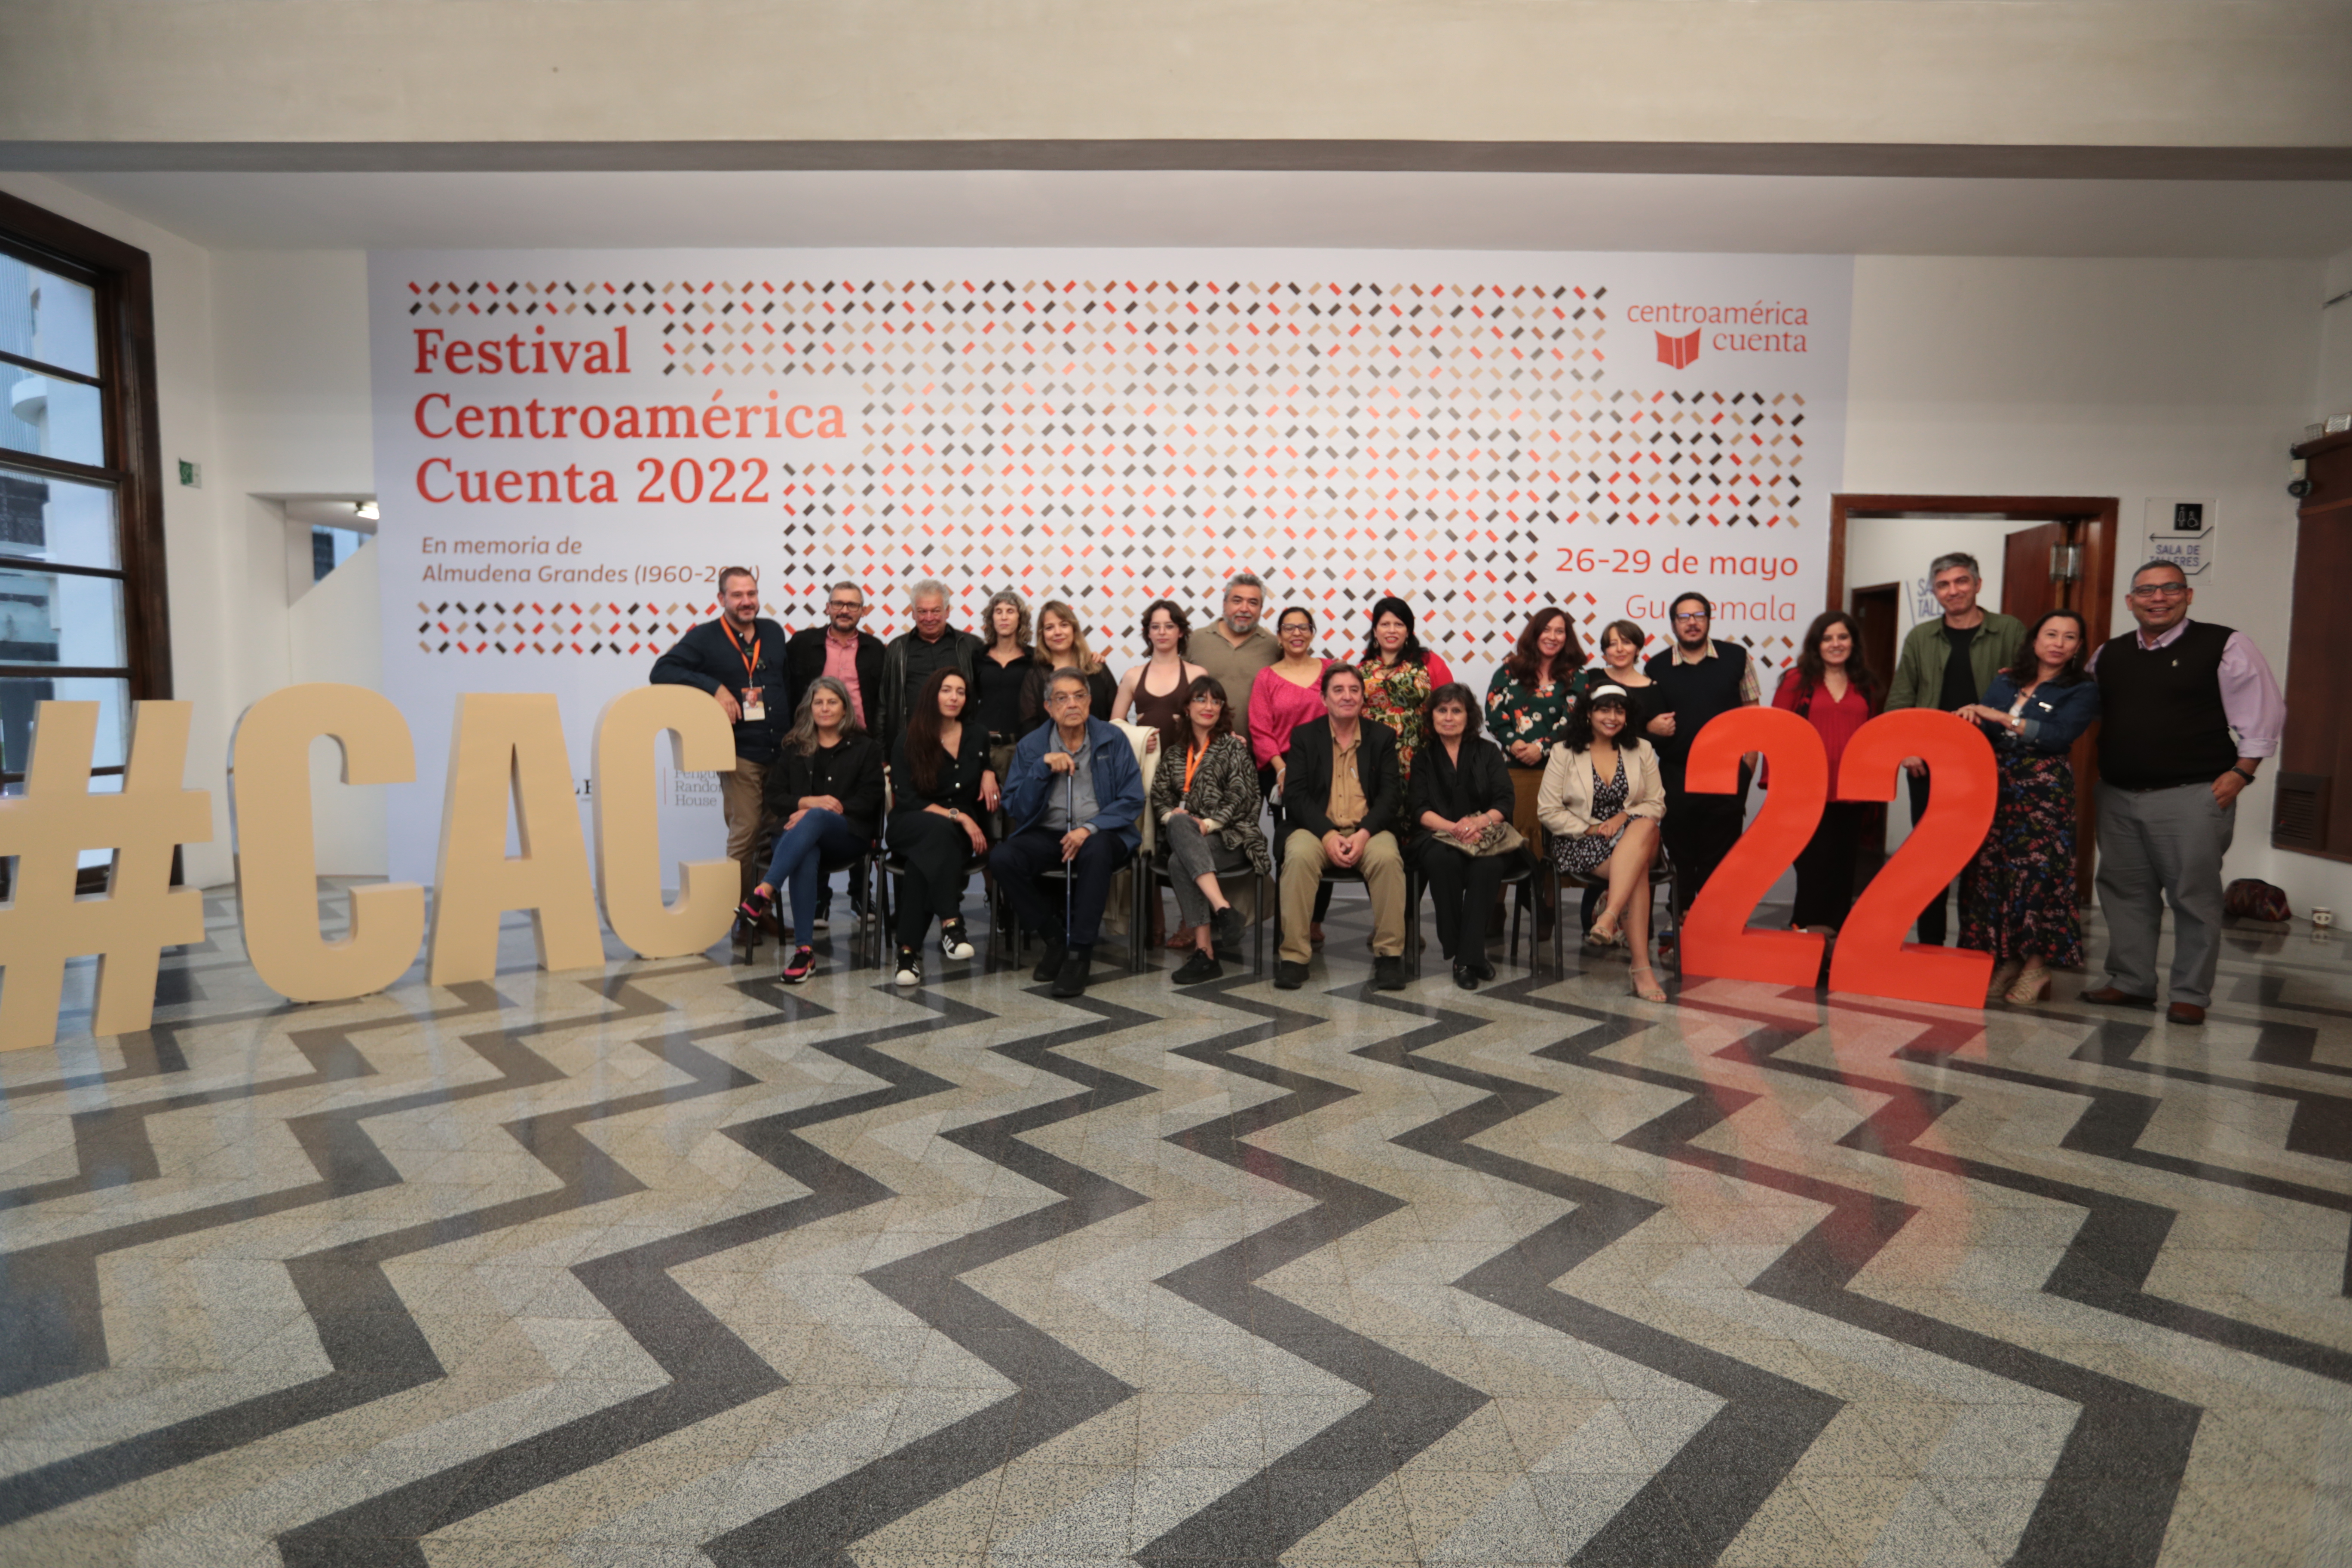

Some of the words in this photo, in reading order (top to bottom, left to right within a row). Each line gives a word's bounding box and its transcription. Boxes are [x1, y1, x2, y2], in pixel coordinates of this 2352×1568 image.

[1627, 300, 1809, 325] centroamérica
[412, 324, 632, 375] Festival
[1712, 332, 1808, 352] cuenta
[413, 388, 848, 439] Centroamérica
[415, 456, 619, 504] Cuenta
[636, 456, 770, 504] 2022
[422, 537, 447, 554] En
[453, 536, 550, 554] memoria
[556, 536, 582, 554] de
[2156, 545, 2182, 554] SALA
[2187, 545, 2201, 555] DE
[422, 564, 532, 583] Almudena
[538, 564, 628, 583] Grandes
[1556, 547, 1652, 574] 26-29
[1661, 547, 1700, 575] de
[1709, 555, 1800, 582] mayo
[1626, 594, 1797, 622] Guemala
[675, 794, 717, 806] House
[0, 683, 741, 1050] #CAC
[1680, 706, 1999, 1009] 22
